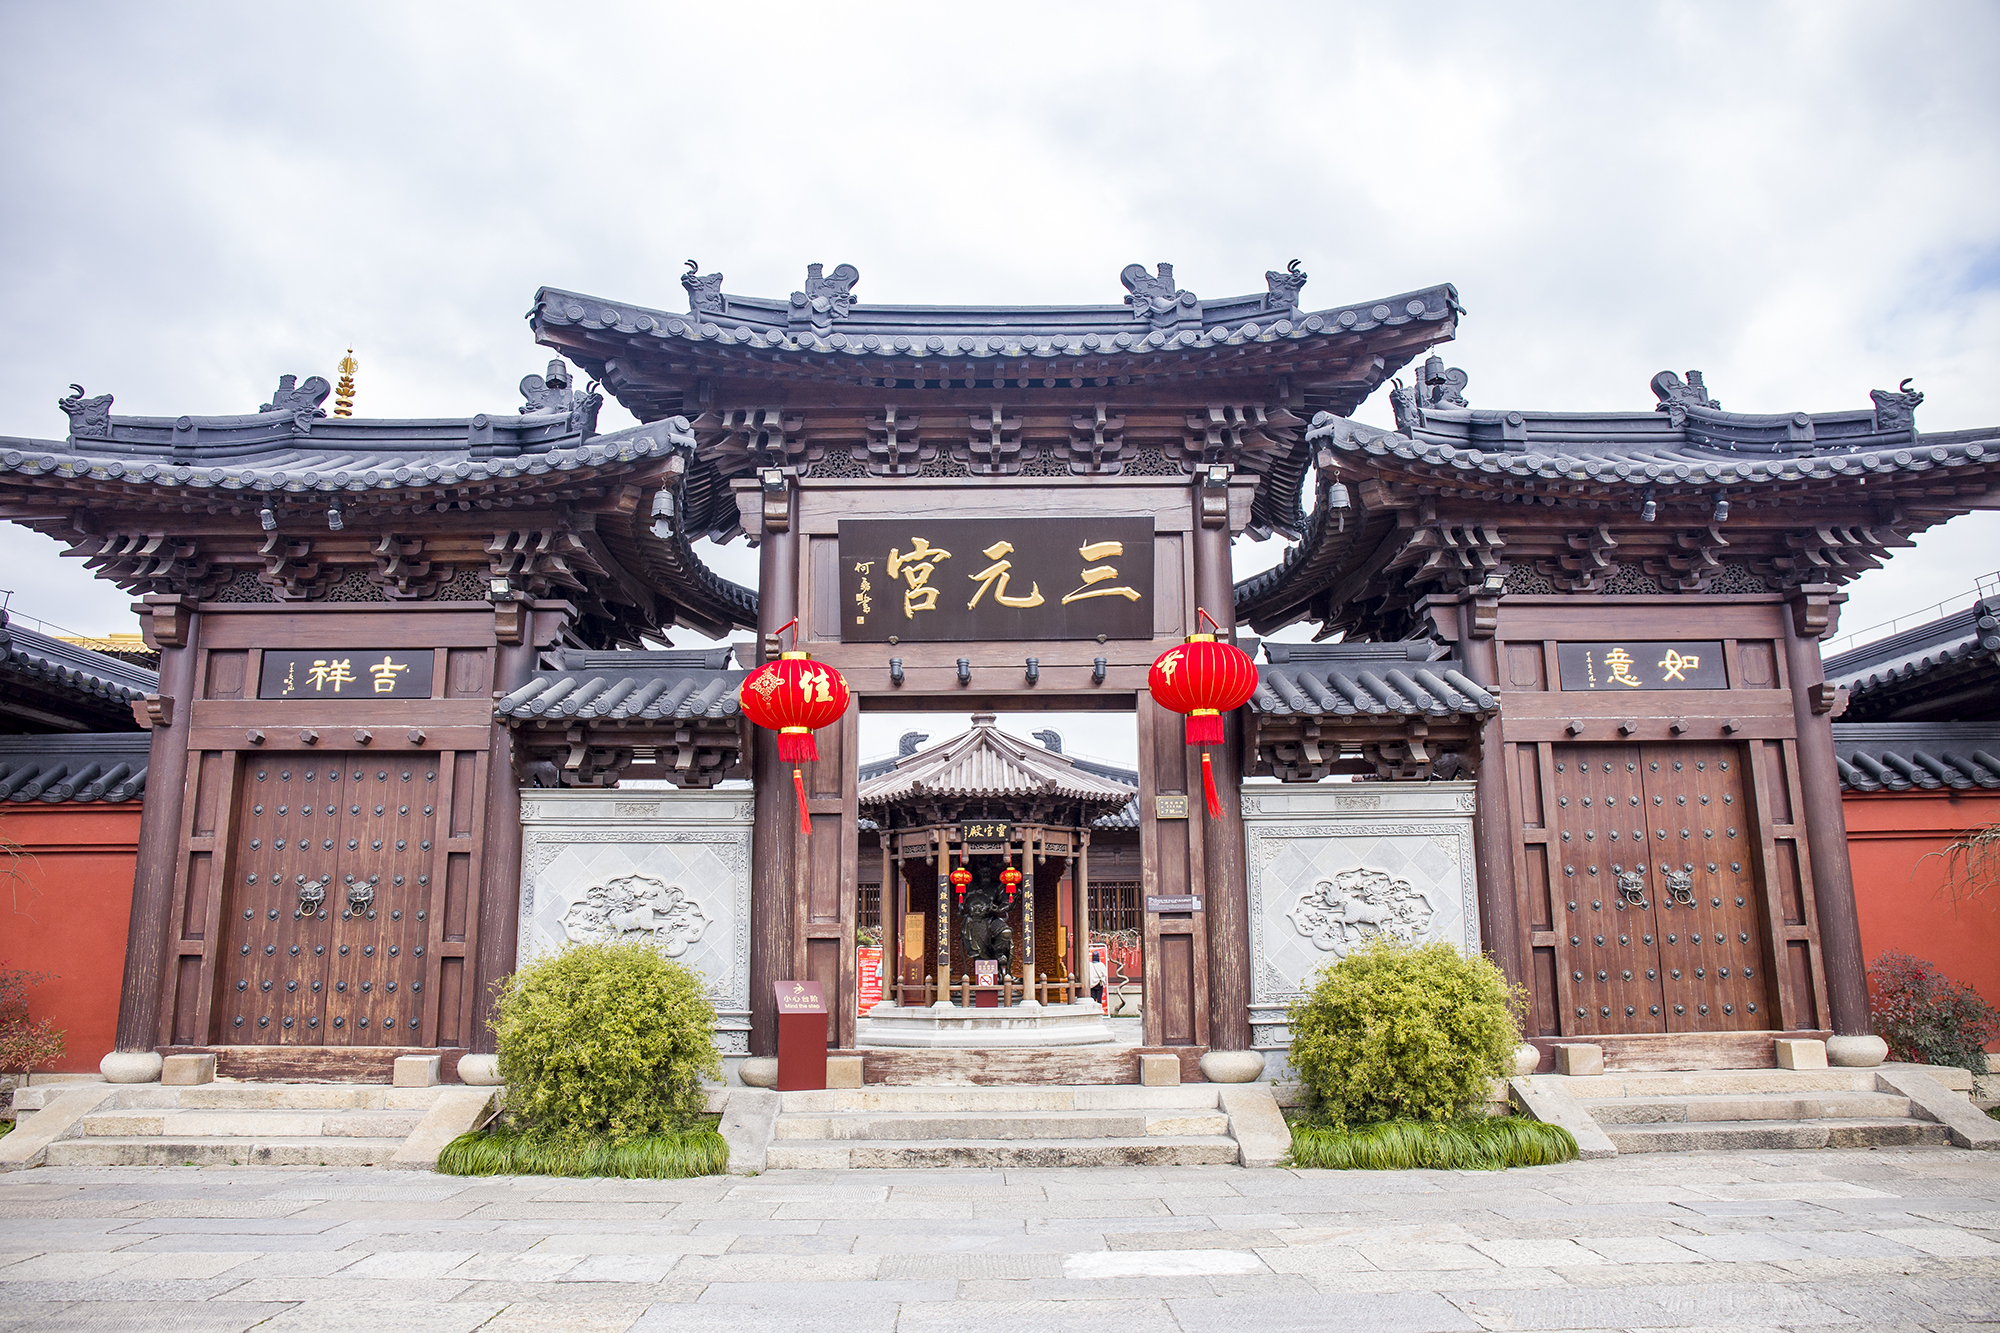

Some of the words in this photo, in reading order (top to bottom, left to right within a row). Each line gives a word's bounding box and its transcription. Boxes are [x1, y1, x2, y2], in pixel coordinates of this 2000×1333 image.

[304, 655, 408, 694] 吉祥
[798, 667, 834, 704] 佳
[1156, 649, 1184, 687] 节
[1603, 647, 1700, 688] 如意
[783, 994, 819, 1003] 小心台阶
